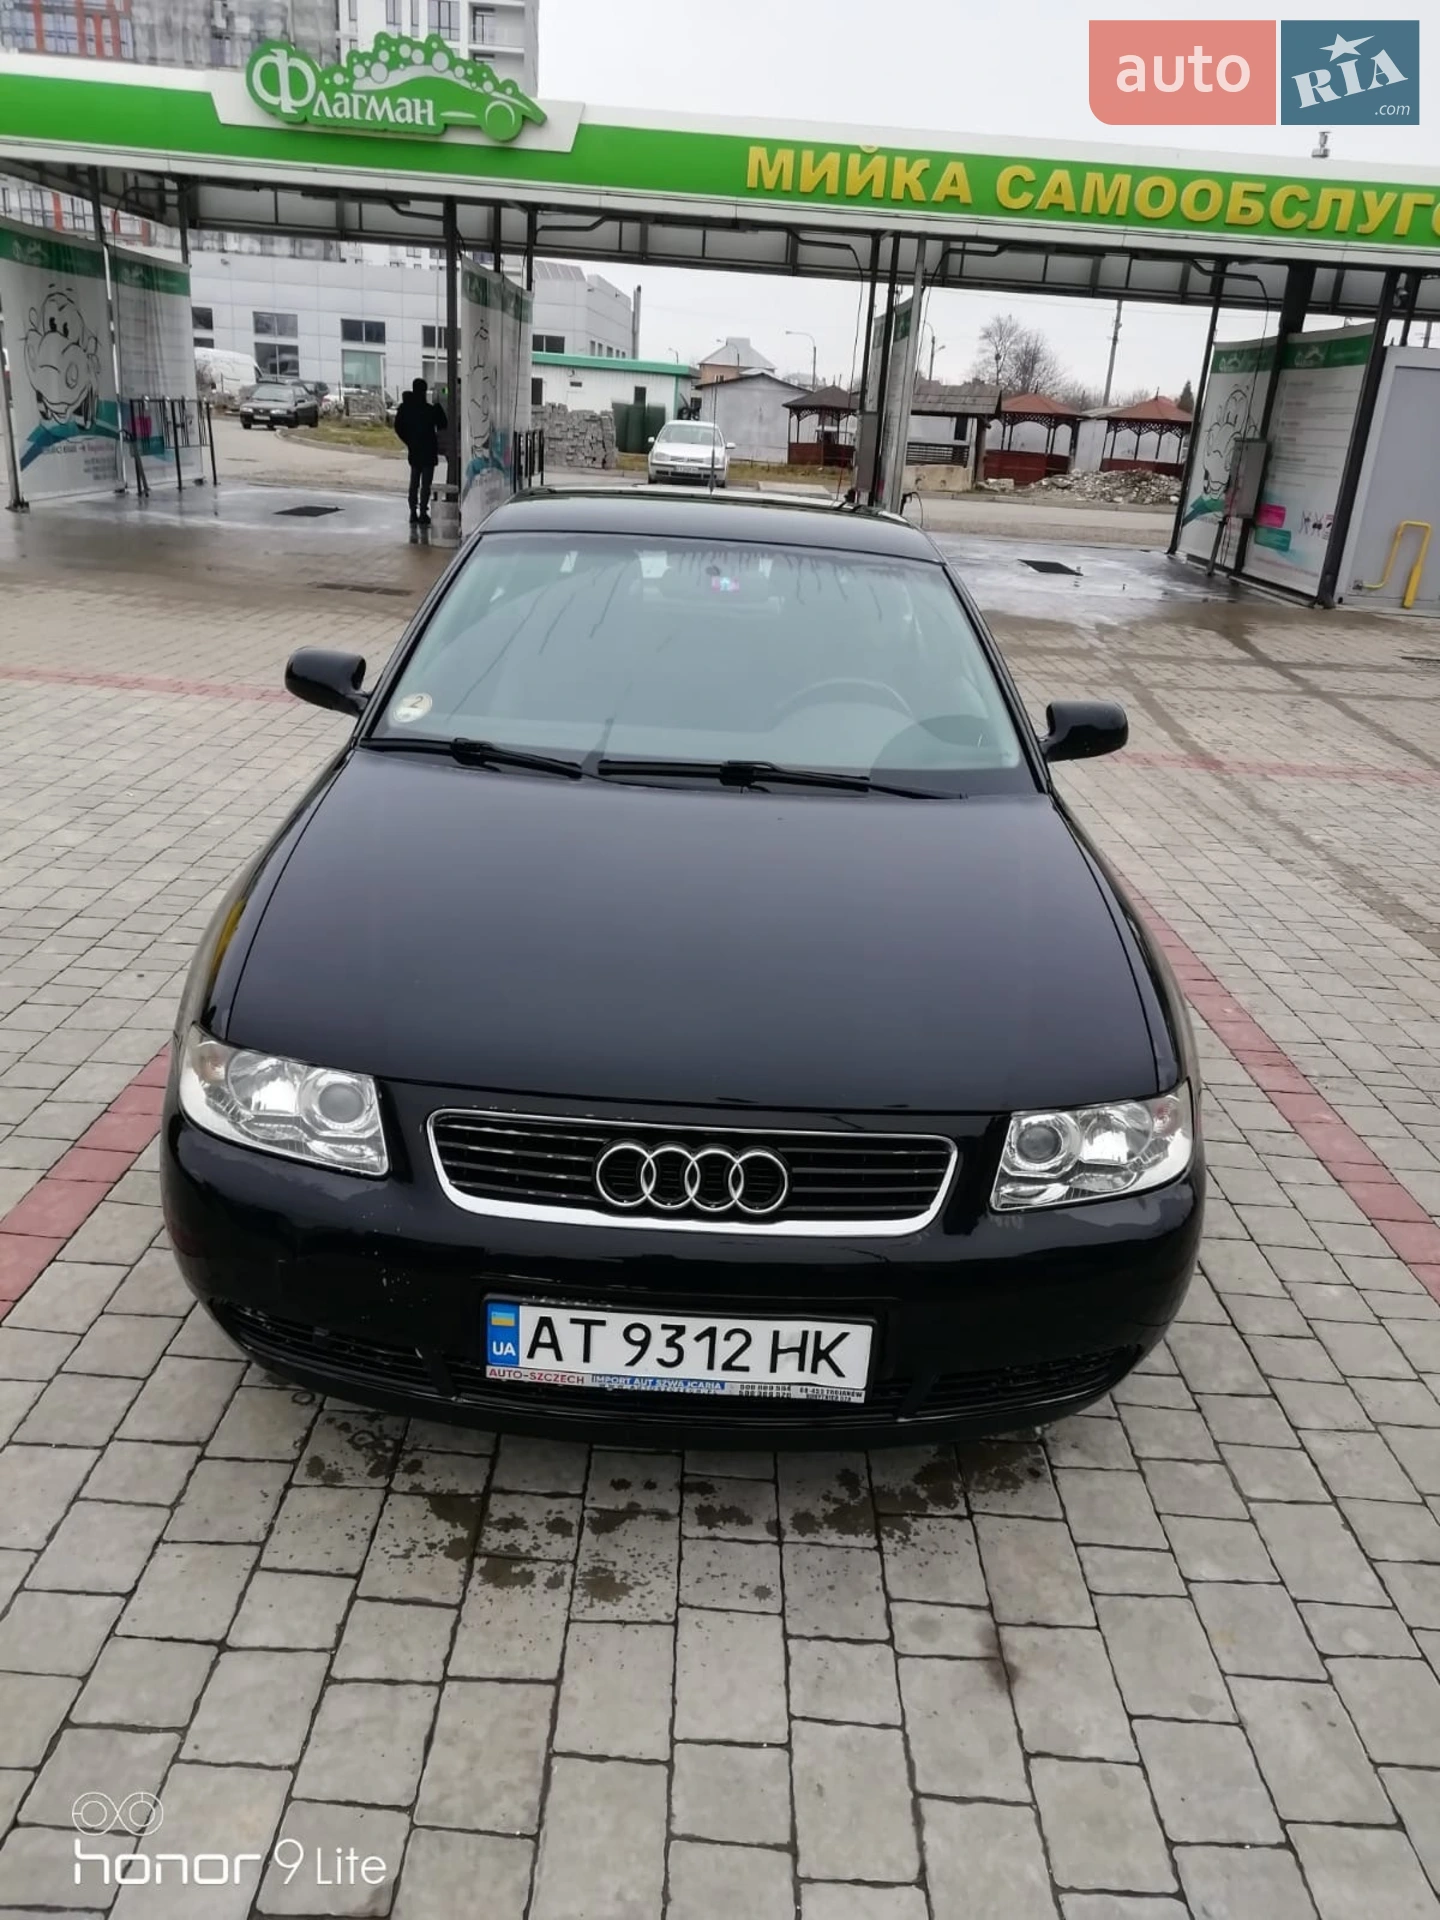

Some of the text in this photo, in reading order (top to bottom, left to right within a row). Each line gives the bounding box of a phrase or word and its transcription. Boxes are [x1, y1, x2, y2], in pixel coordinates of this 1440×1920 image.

[252, 49, 436, 126] Флагман
[747, 144, 1440, 237] МИЙКА САМООБСЛУГ
[489, 1368, 585, 1385] AUTO-SZCZECH
[492, 1341, 516, 1356] UA
[527, 1315, 851, 1379] AT 9312 HK
